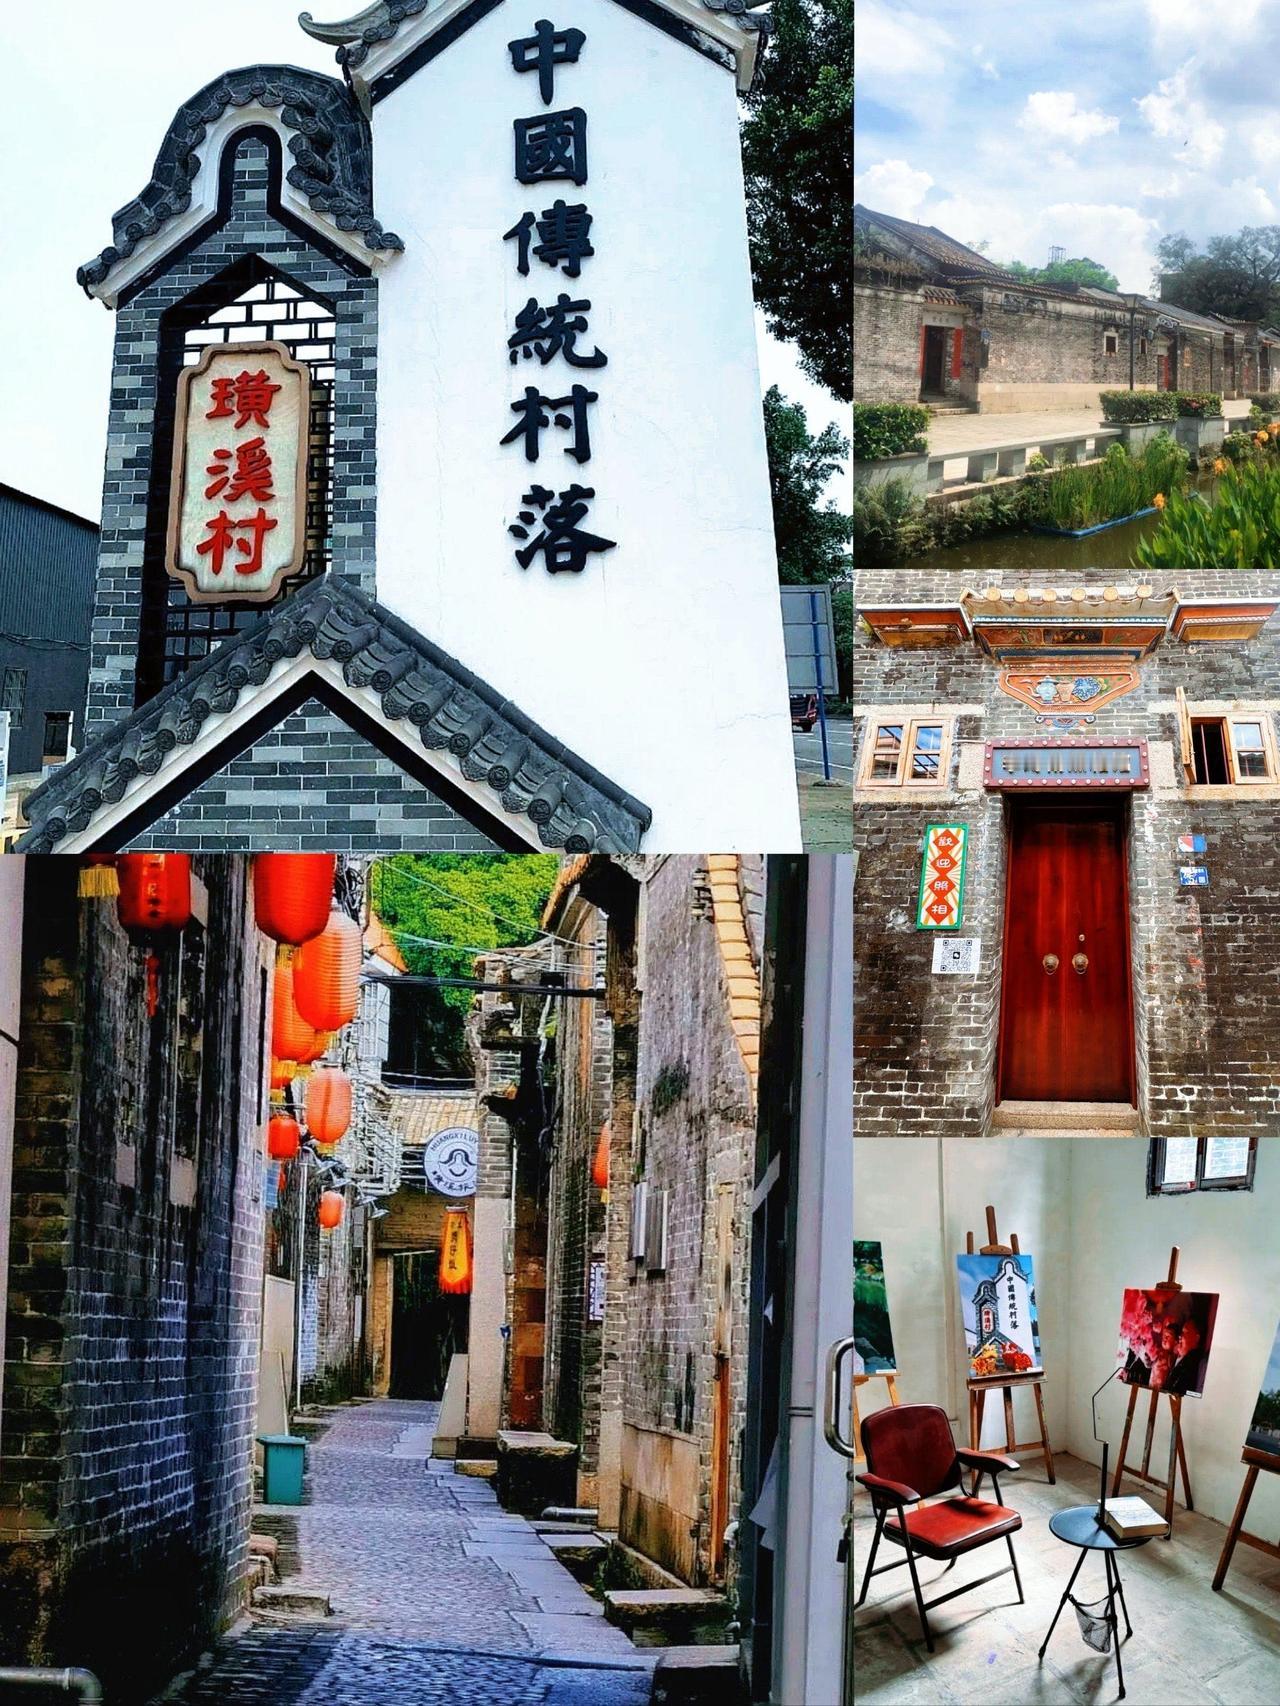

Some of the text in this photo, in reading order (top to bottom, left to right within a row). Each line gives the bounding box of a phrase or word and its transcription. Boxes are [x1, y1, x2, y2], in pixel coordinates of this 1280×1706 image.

[197, 370, 281, 576] 璜溪村
[501, 19, 616, 573] 中國傳統村落
